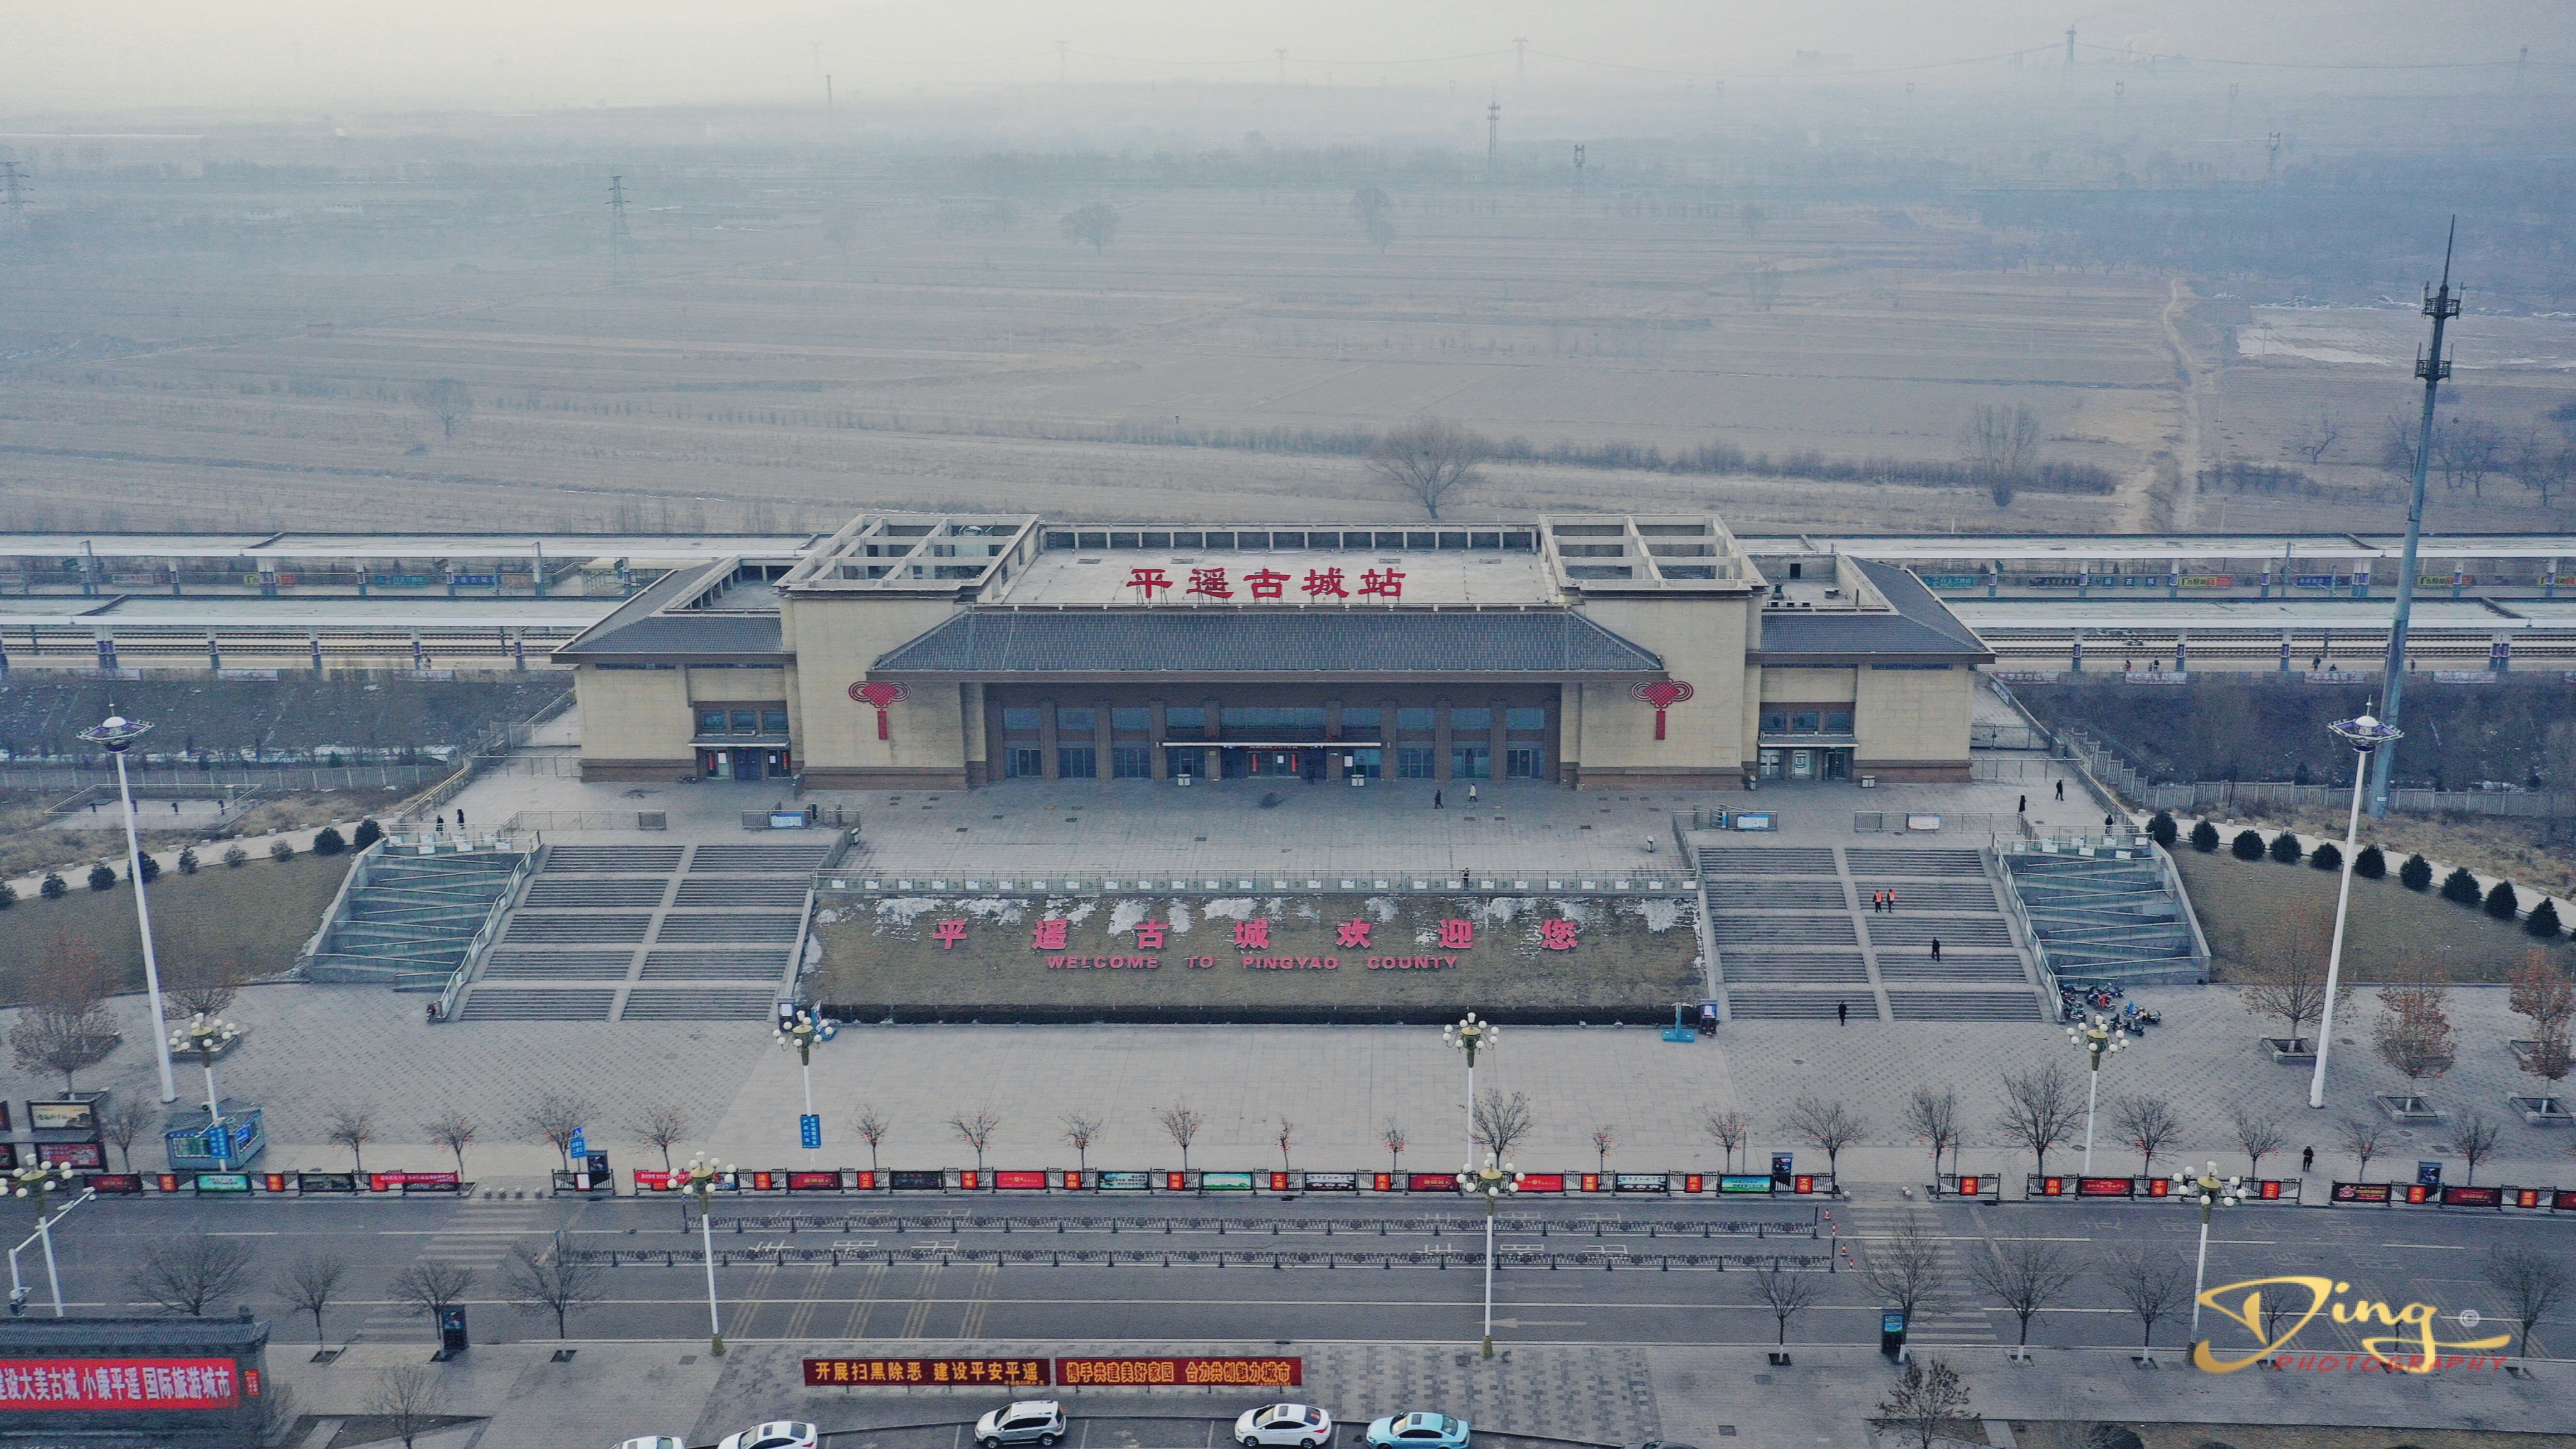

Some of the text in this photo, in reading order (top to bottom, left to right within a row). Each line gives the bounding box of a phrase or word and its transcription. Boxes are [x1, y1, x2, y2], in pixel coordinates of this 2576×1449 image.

[1126, 567, 1406, 598] 平遥古城站
[932, 917, 1579, 950] 平遥古城欢迎您
[1046, 955, 1457, 970] WELCOME TO PINGYAO COUNTY
[861, 1174, 872, 1188] 公正
[964, 1173, 973, 1187] 平等
[1067, 1174, 1077, 1187] 自由
[1171, 1174, 1180, 1188] 和谐
[1274, 1174, 1283, 1188] 文明
[1378, 1175, 1387, 1189] 民主
[1585, 1176, 1594, 1190] 富强
[1689, 1176, 1698, 1191] 民主
[1799, 1178, 1809, 1191] 文明
[1965, 1179, 1974, 1194] 和谐
[2048, 1180, 2058, 1194] 自由
[815, 1362, 1038, 1382] 开展扫黑除恶 建设平安平遥
[1066, 1361, 1291, 1383] 携手共建美好家园 合力共创魅力城市
[82, 1367, 143, 1401] 小康平遥
[142, 1366, 232, 1401] 国际旅游城市
